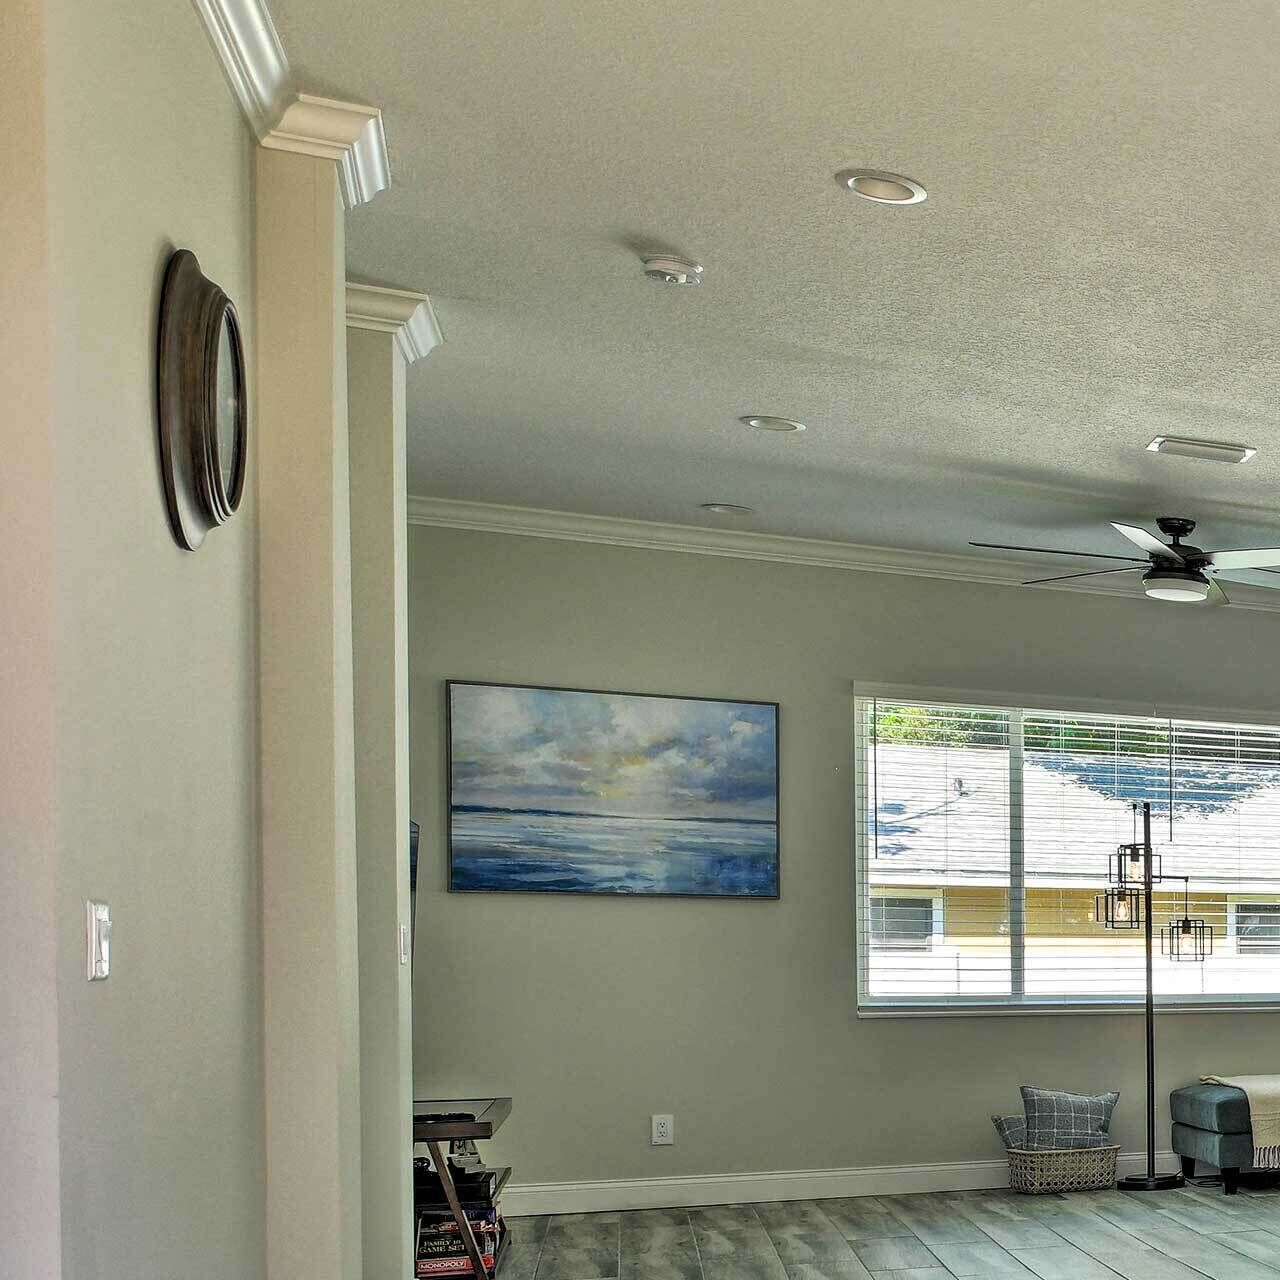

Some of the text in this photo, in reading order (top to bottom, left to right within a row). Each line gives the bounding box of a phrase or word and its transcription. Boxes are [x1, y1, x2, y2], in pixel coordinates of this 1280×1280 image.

[423, 1239, 450, 1247] FAMILY
[419, 1244, 465, 1254] GAME SET
[420, 1260, 465, 1270] MONOPOLY
